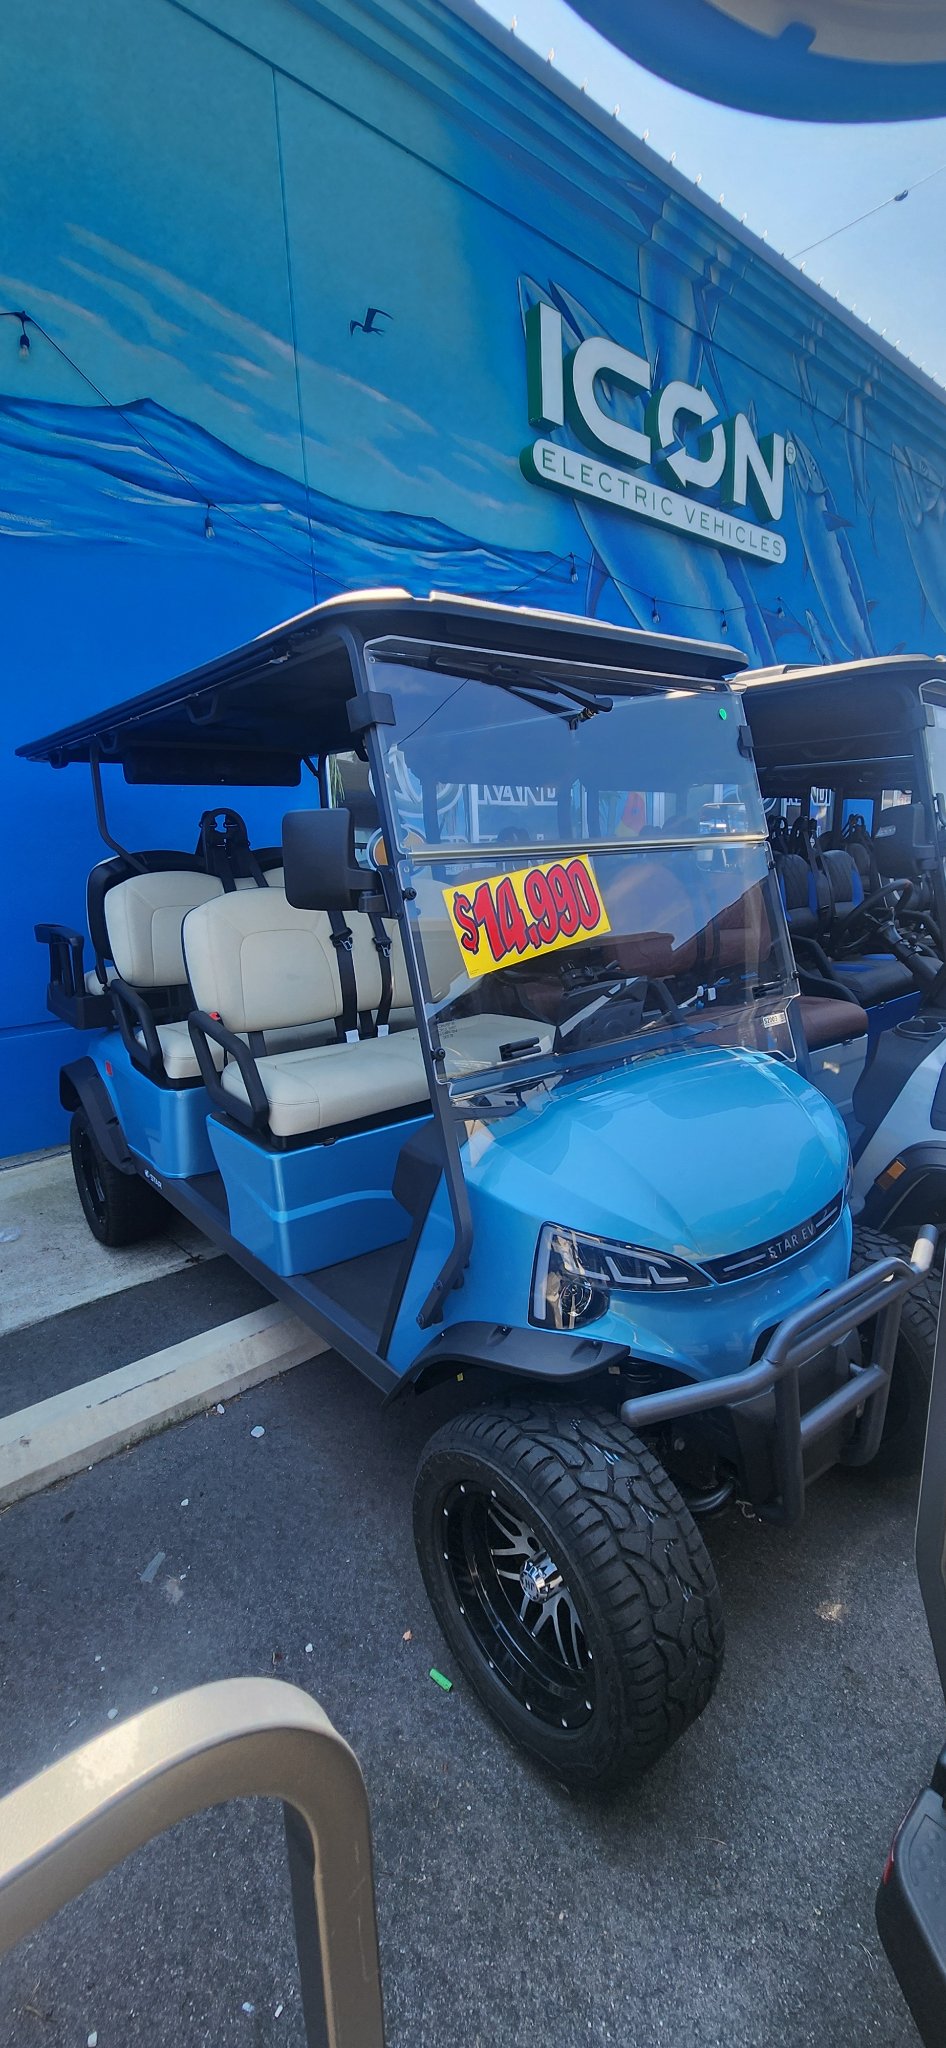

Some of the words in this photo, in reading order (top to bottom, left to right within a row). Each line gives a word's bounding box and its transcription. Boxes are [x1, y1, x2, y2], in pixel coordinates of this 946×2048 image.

[537, 301, 785, 521] ICON
[541, 447, 673, 517] ELECTRIC
[684, 504, 782, 559] VEHICLES
[768, 1234, 799, 1258] STAR
[801, 1223, 815, 1240] EV
